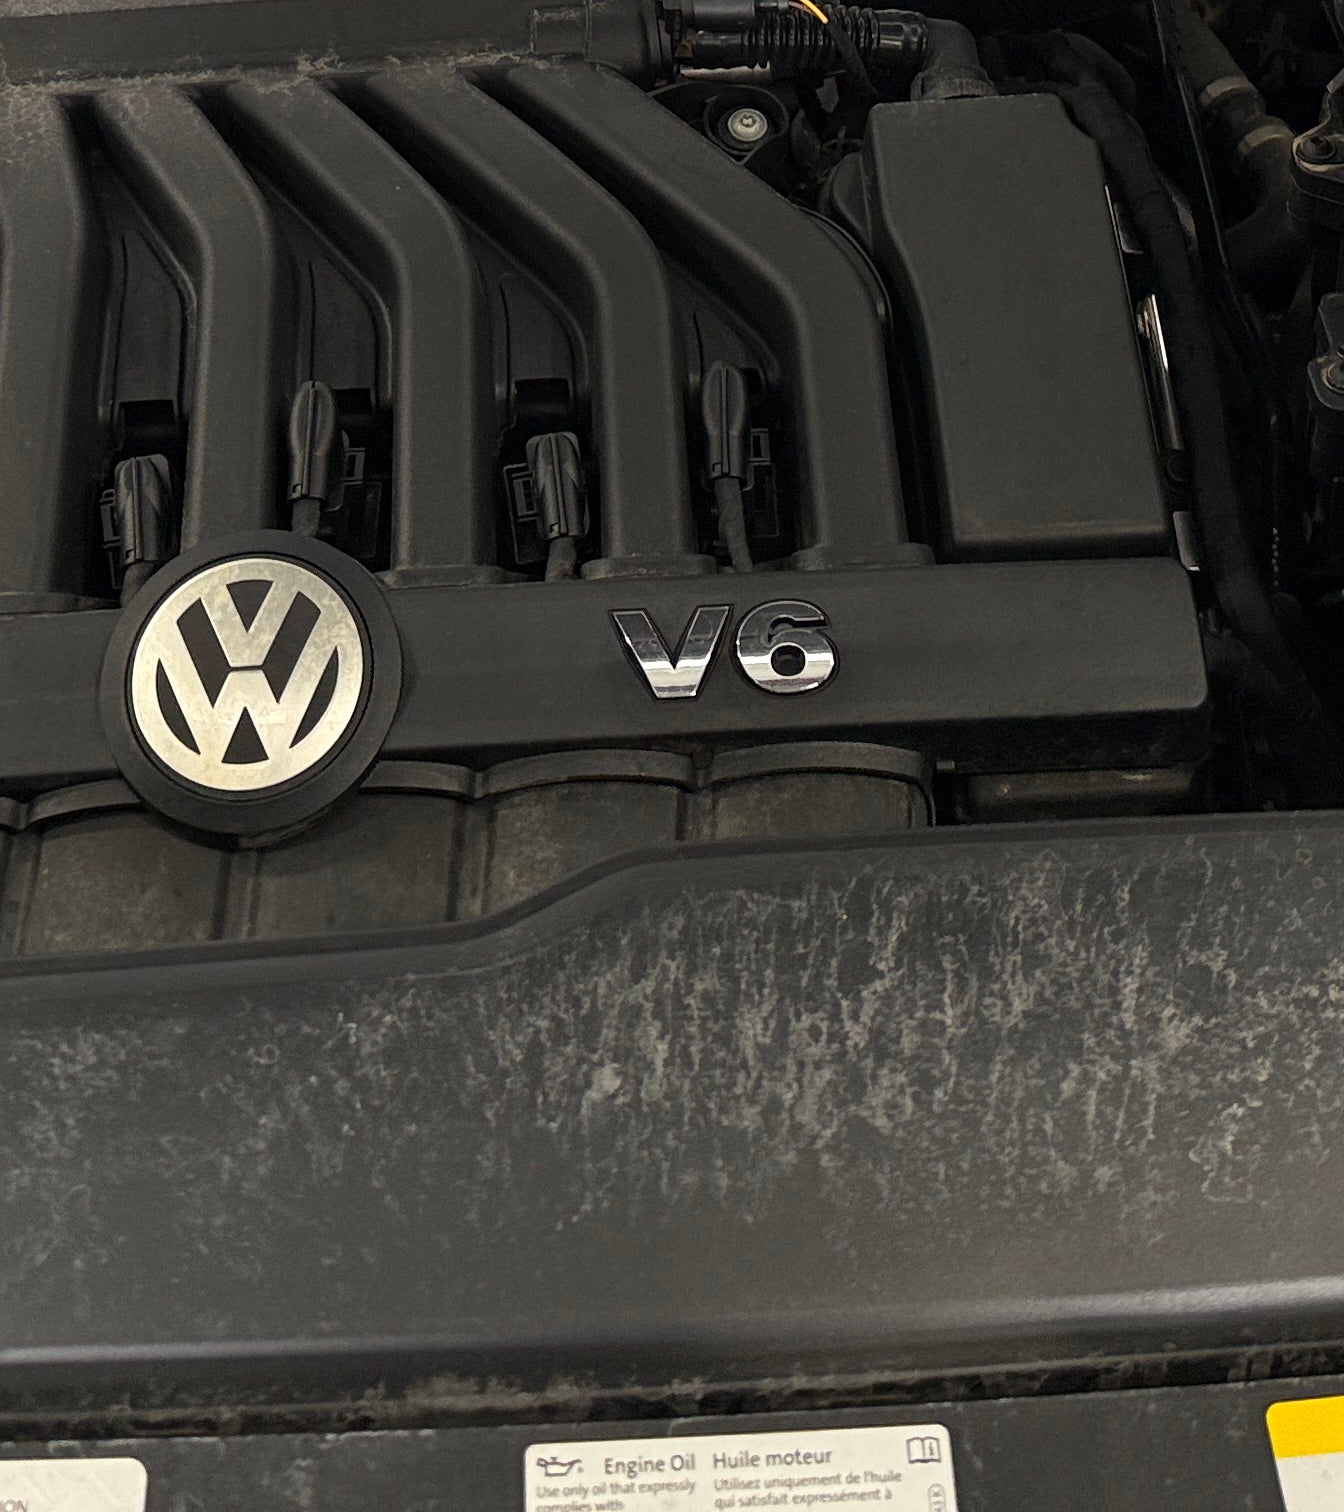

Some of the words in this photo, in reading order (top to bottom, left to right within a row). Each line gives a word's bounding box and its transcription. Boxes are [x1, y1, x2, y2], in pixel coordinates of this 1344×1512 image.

[609, 599, 840, 702] V6
[132, 558, 363, 791] VW
[605, 1455, 665, 1479] Engine
[670, 1453, 696, 1472] Oil
[713, 1450, 760, 1469] Huile
[765, 1448, 833, 1467] moteur
[536, 1486, 559, 1498] Use
[563, 1483, 589, 1500] only
[591, 1482, 607, 1495] oil
[609, 1481, 636, 1495] that
[638, 1478, 696, 1496] expressly
[714, 1476, 761, 1492] Utilisez
[764, 1473, 842, 1491] uniquement
[845, 1472, 861, 1485] de
[864, 1469, 902, 1484] l'huile
[595, 1498, 624, 1511] with
[714, 1495, 736, 1511] qui
[739, 1490, 789, 1507] satisfait
[792, 1489, 882, 1507] expressément
